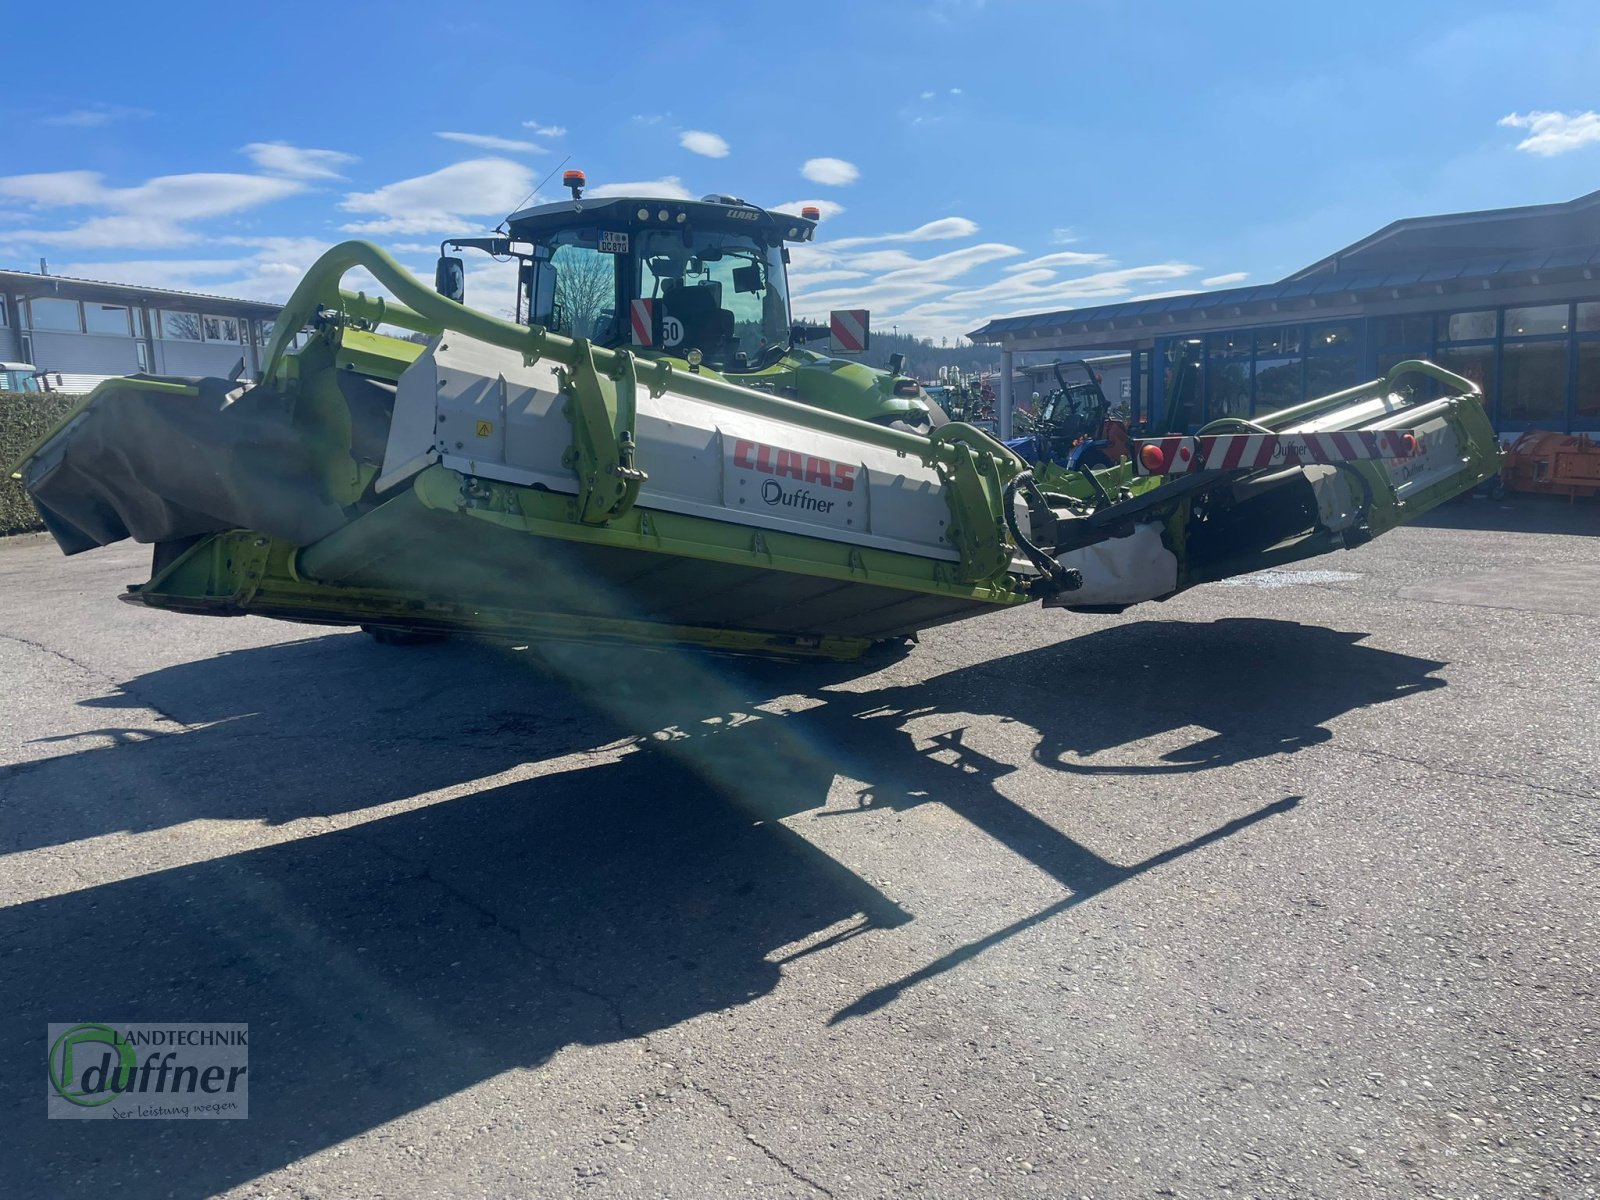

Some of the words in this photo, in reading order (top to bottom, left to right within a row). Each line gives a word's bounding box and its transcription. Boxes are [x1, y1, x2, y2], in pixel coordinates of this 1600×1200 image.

[727, 209, 759, 220] CLAAS
[663, 321, 679, 341] 50
[733, 440, 856, 492] CLAAS
[761, 478, 835, 514] Duffner
